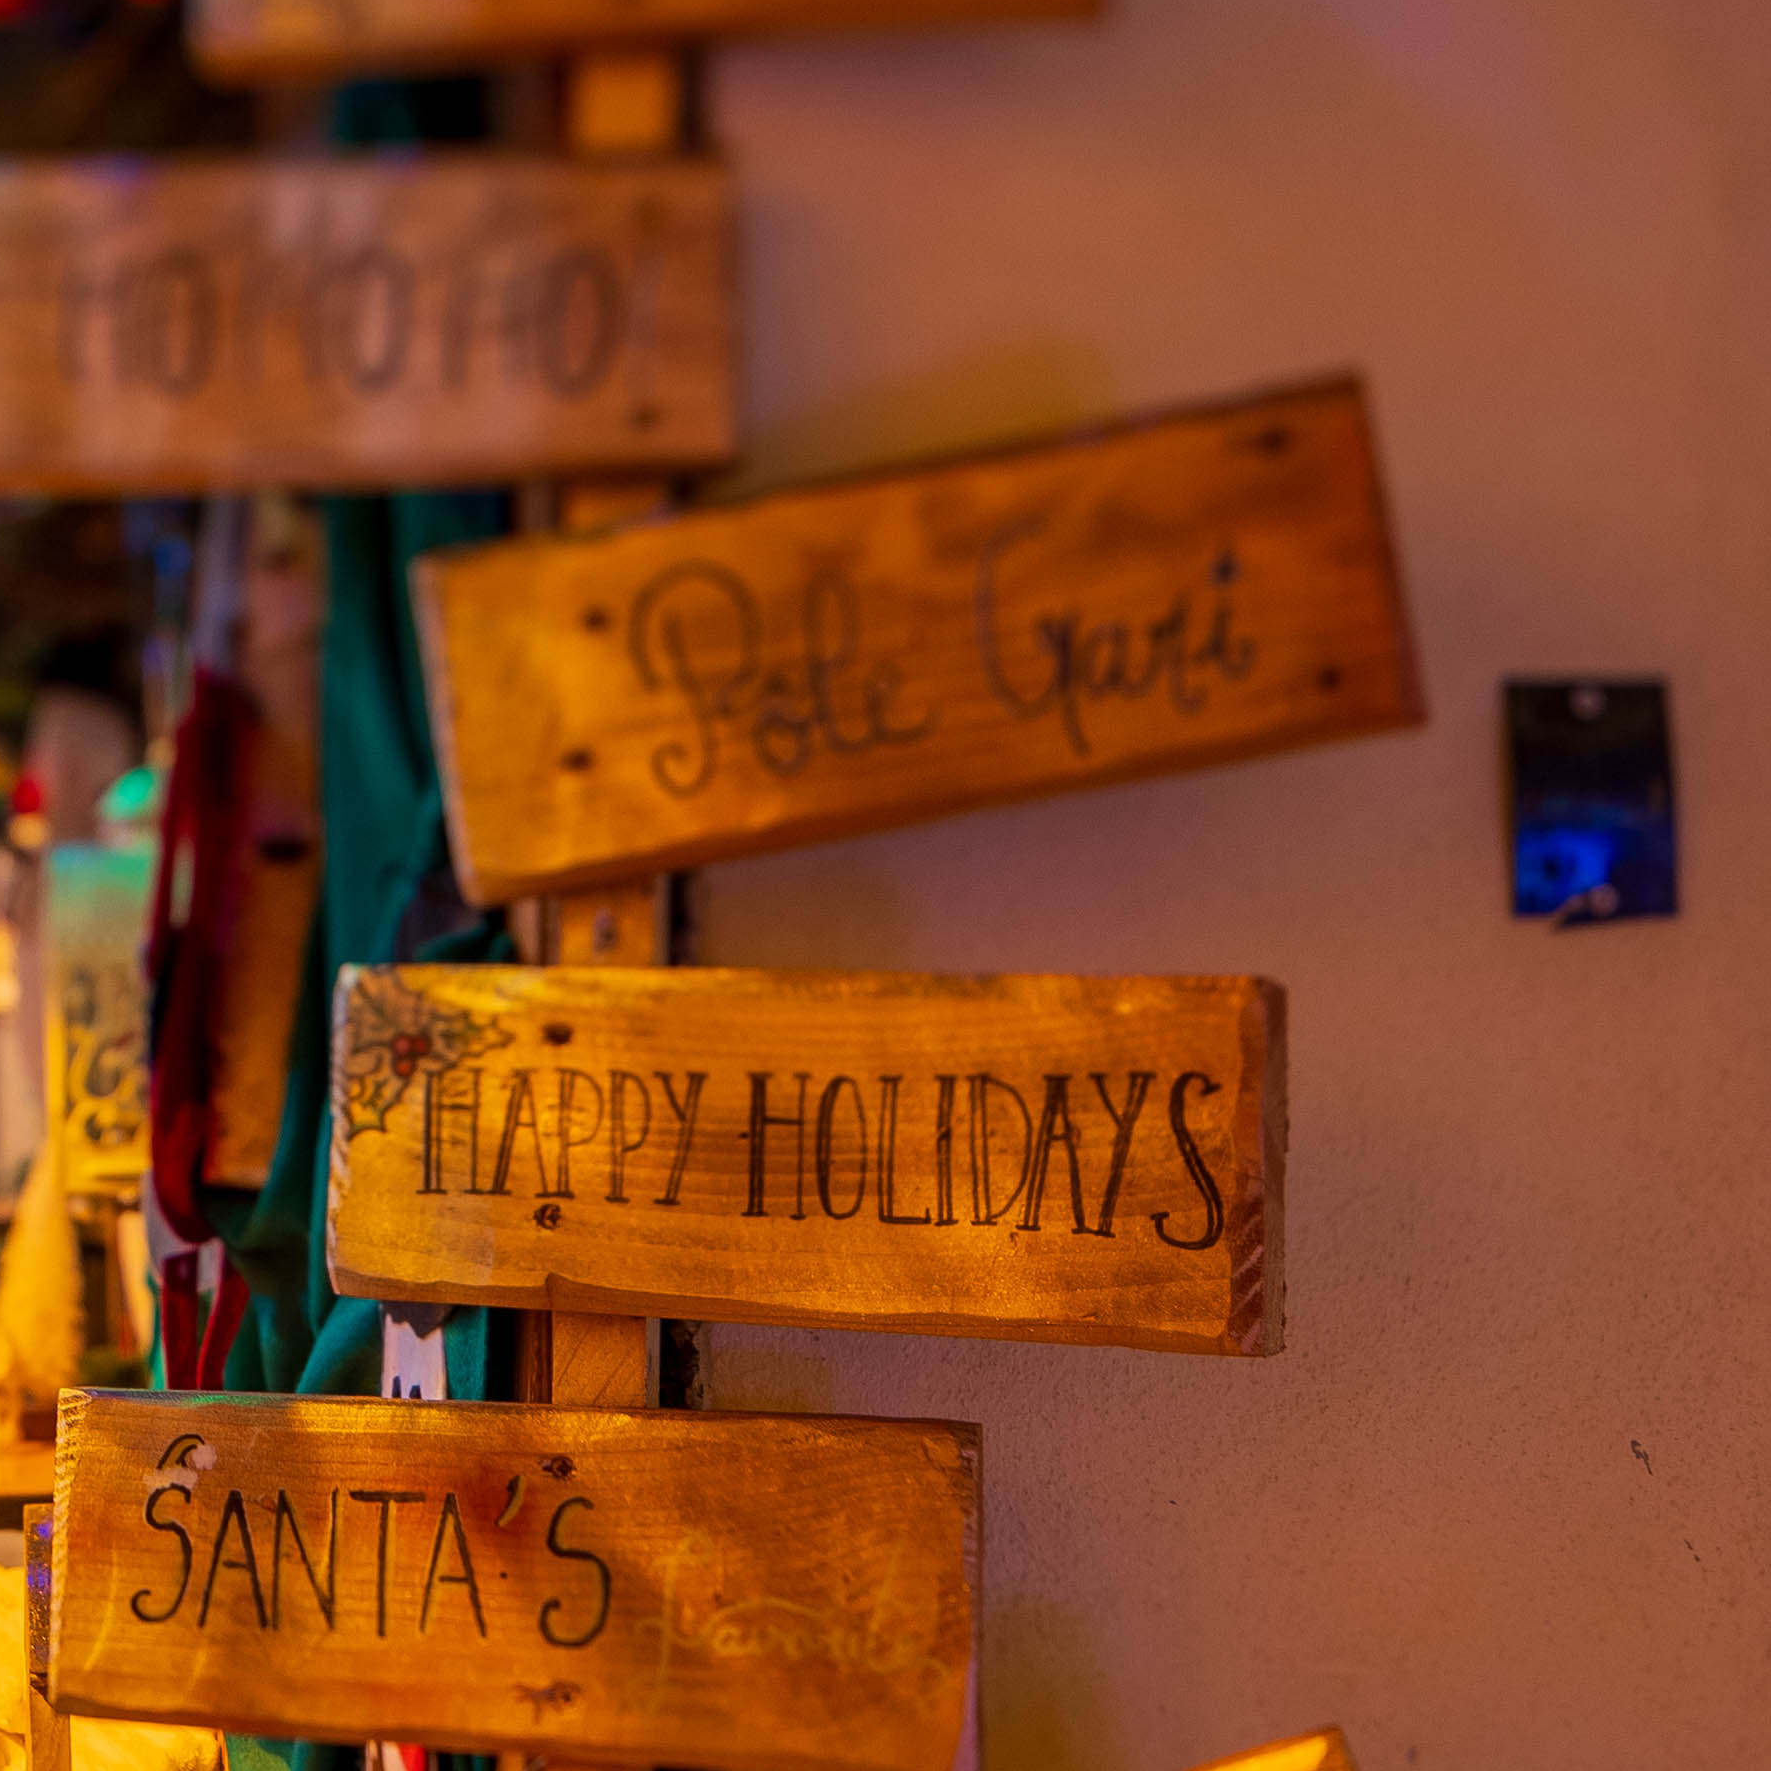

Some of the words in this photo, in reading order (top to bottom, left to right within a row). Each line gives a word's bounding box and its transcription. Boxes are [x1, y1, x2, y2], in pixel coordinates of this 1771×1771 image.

[416, 1066, 708, 1206] HAPPY
[740, 1070, 1225, 1251] HOLIDAYS
[130, 1474, 612, 1648] SANTA'S
